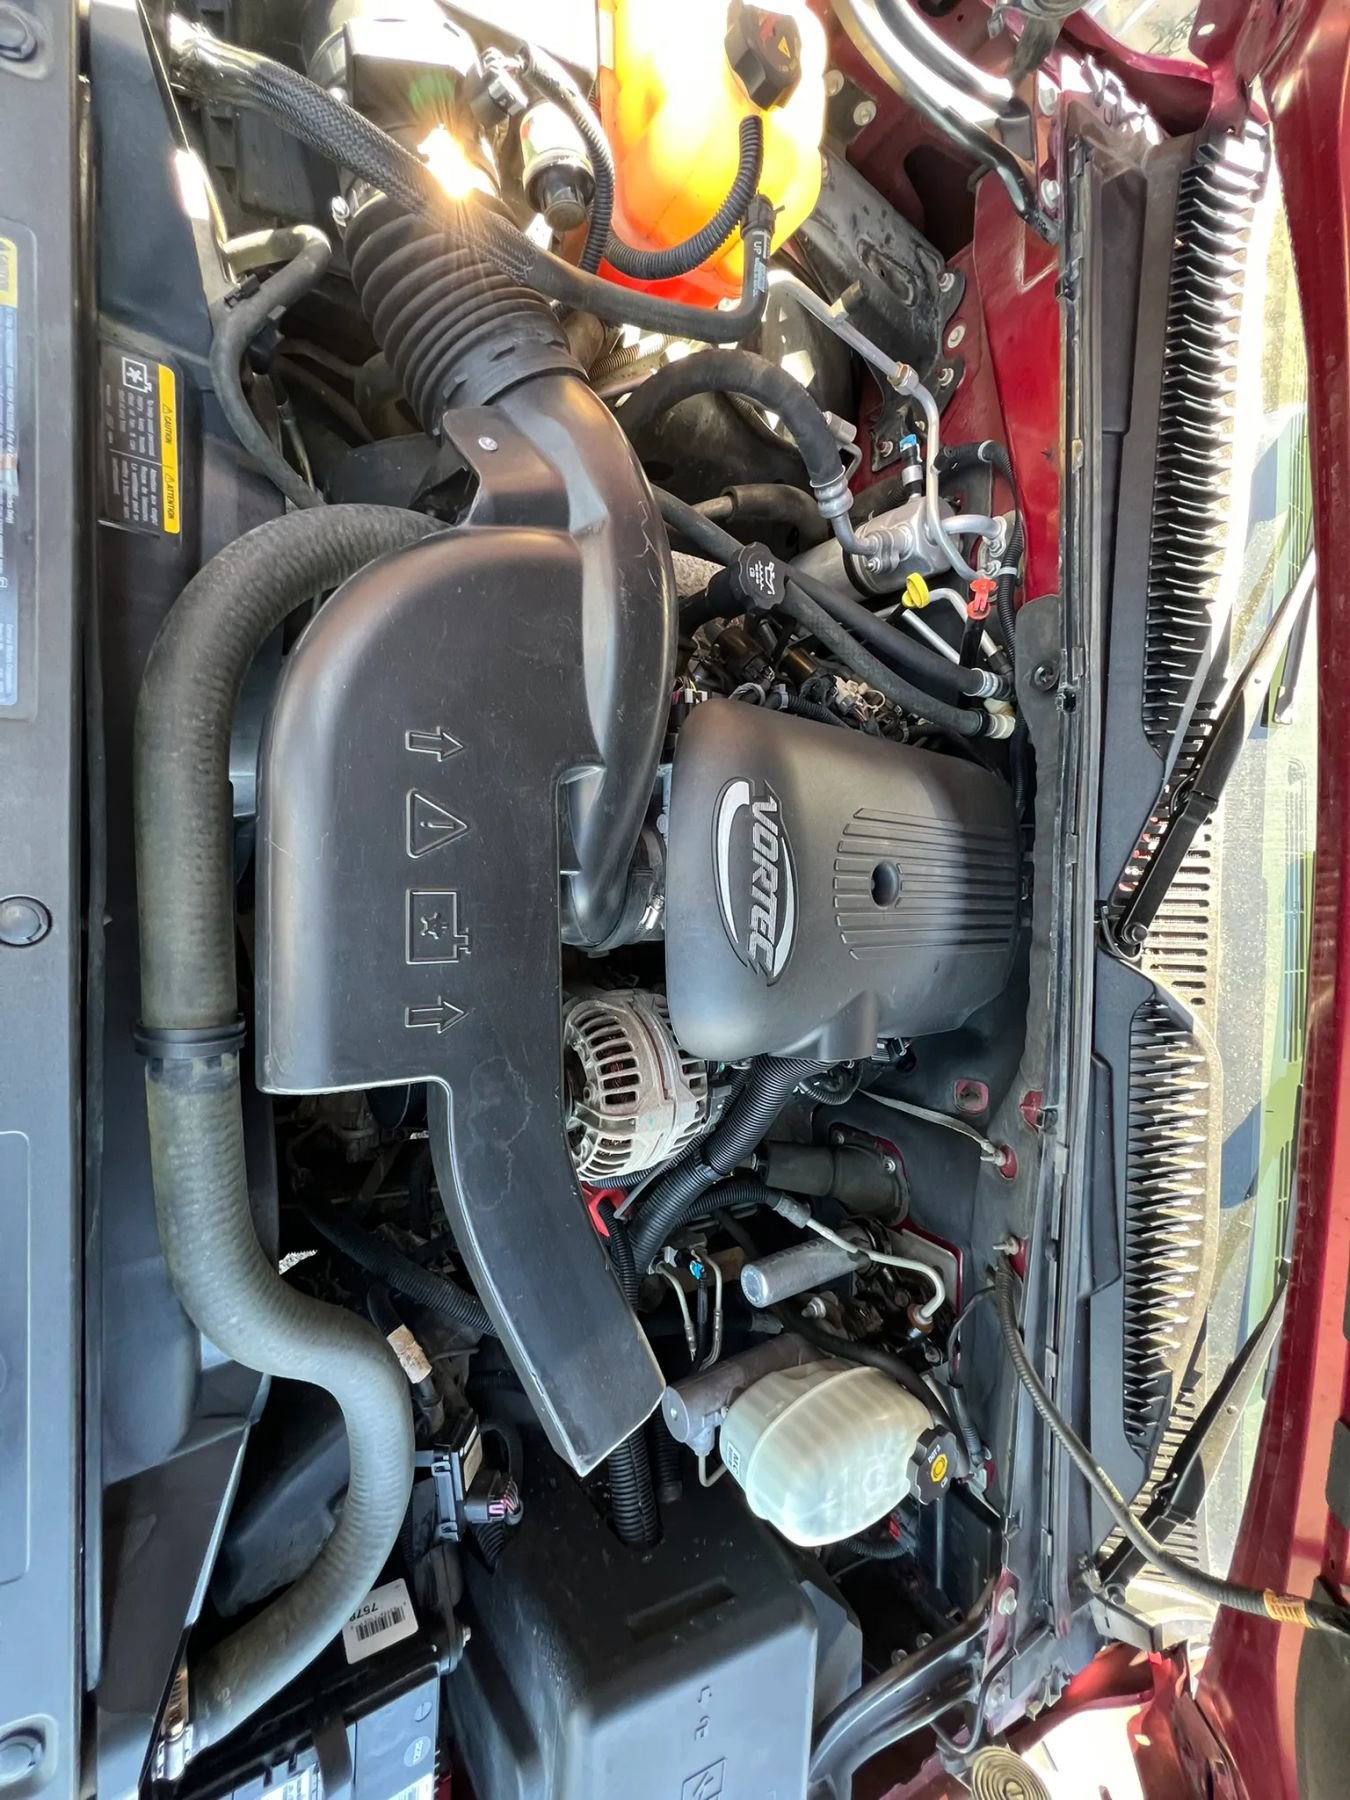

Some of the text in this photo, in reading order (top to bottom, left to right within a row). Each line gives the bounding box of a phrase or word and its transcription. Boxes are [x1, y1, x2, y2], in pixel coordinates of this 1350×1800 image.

[754, 241, 762, 255] UP
[164, 415, 172, 444] CAUTION
[166, 484, 174, 520] ATTENTION
[748, 796, 779, 972] VORTEC
